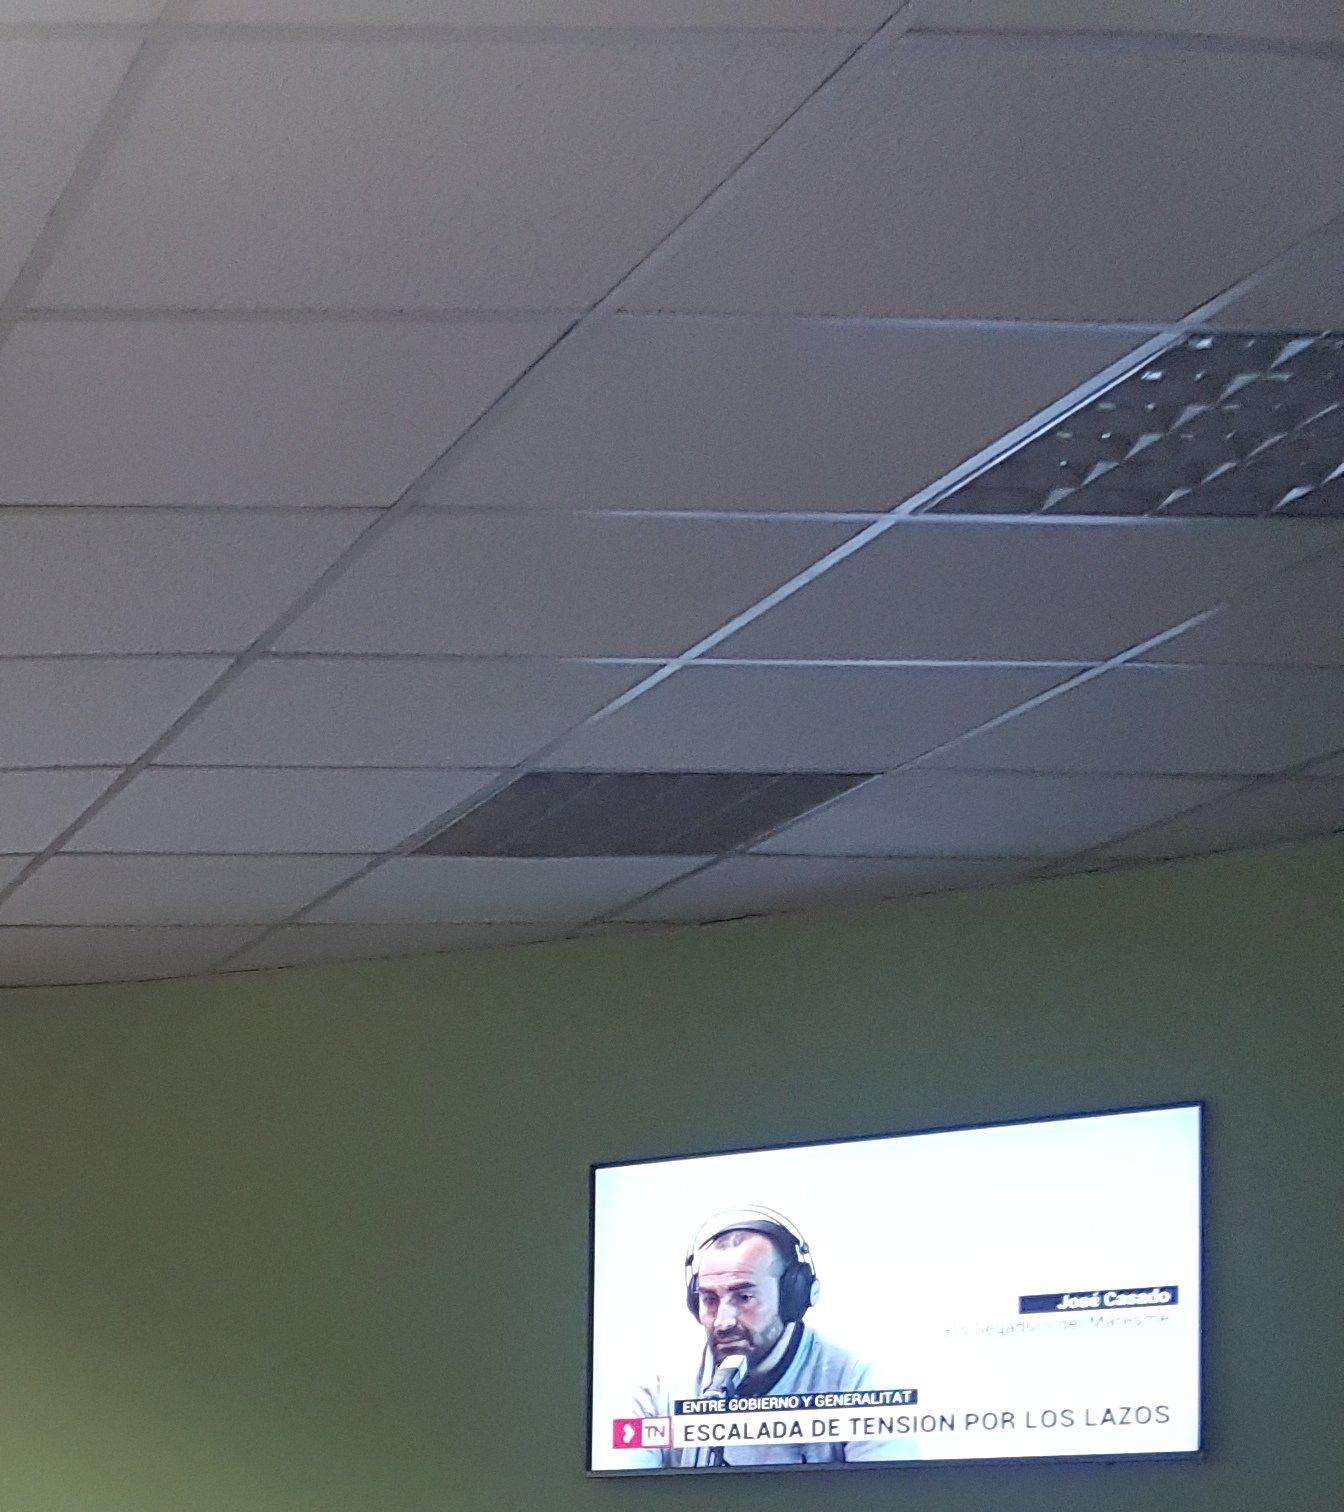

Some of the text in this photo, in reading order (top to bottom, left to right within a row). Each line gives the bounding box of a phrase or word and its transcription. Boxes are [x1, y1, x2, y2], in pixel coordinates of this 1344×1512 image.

[1057, 1287, 1171, 1310] José Casado
[682, 1390, 913, 1414] ENTRE GOBIERNO Y GENERALITAT
[644, 1425, 665, 1440] TN
[683, 1420, 804, 1443] ESCALADA
[812, 1420, 840, 1437] DE
[965, 1411, 1015, 1431] POR
[1026, 1409, 1075, 1428] LOS
[1085, 1405, 1171, 1426] LAZOS
